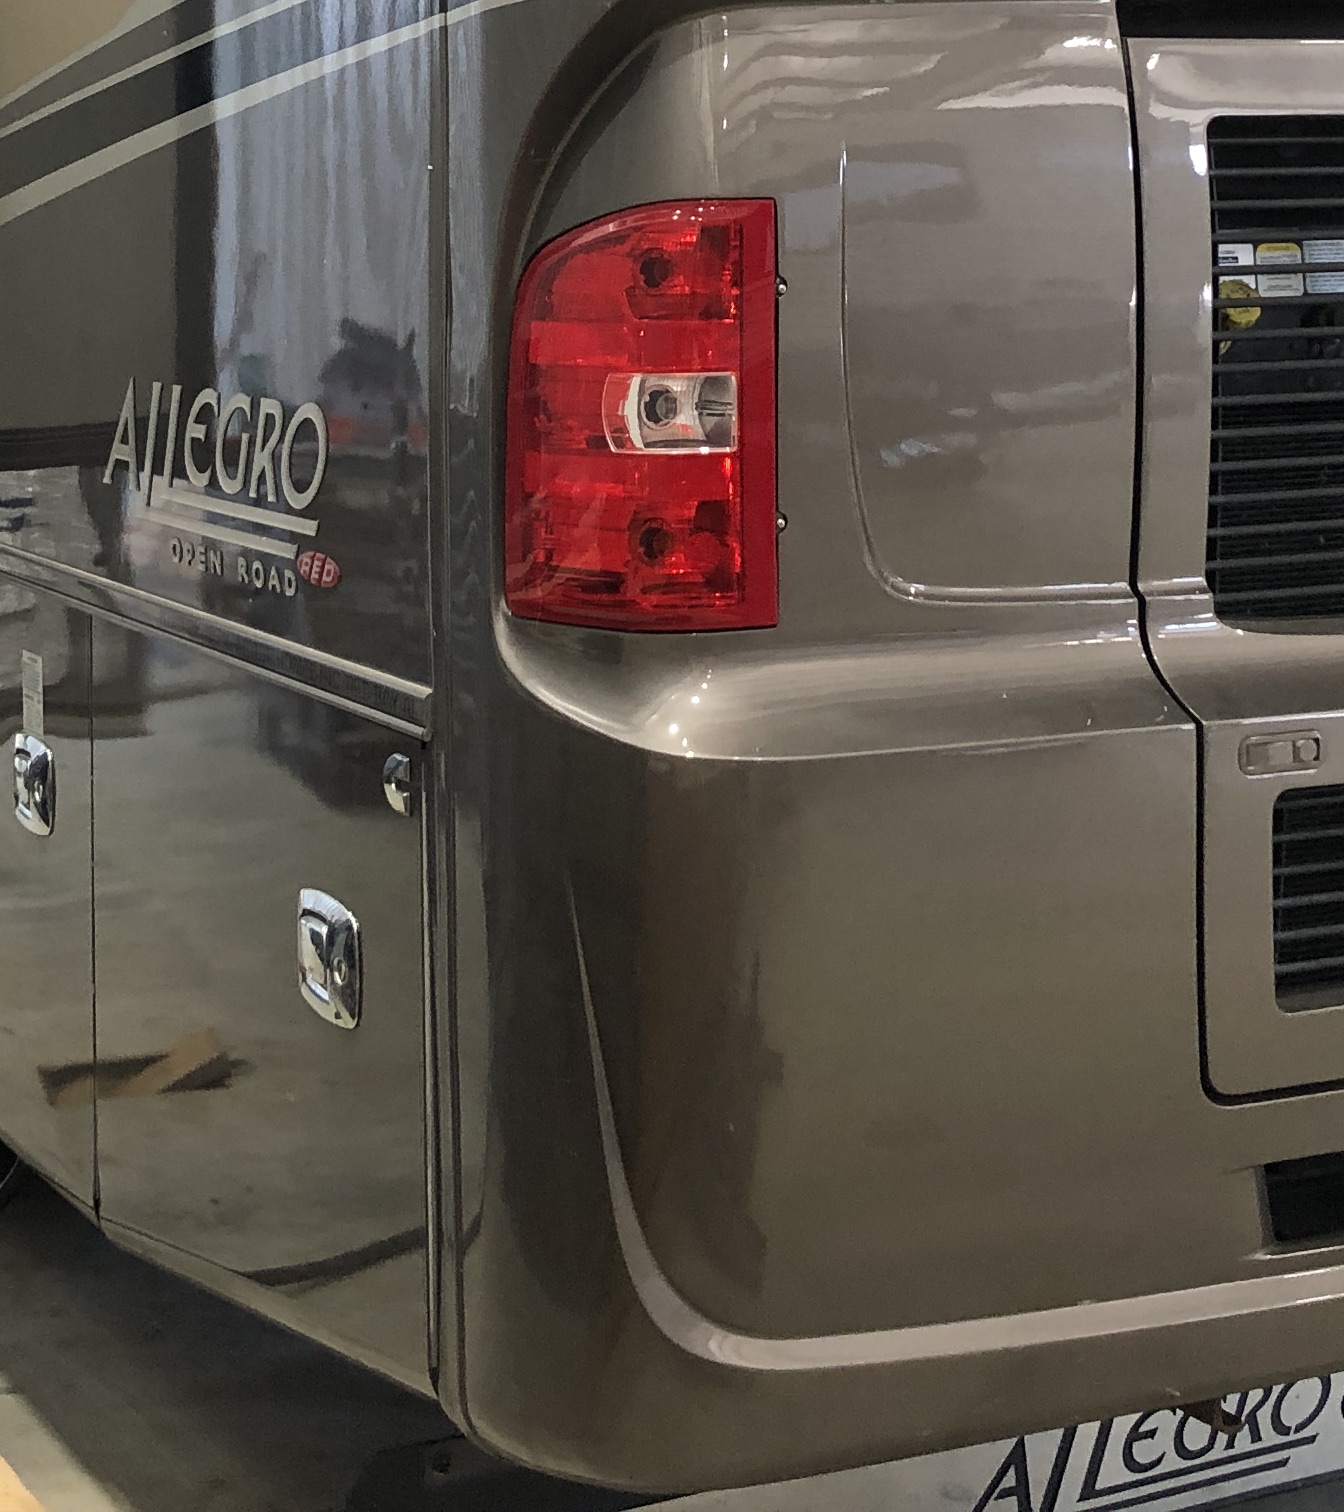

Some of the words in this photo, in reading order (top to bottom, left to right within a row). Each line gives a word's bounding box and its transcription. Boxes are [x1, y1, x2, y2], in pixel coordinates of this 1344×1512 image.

[102, 375, 330, 534] ALLEGRO
[169, 538, 224, 576] OPEN
[237, 556, 299, 597] ROAD
[300, 552, 337, 585] RED
